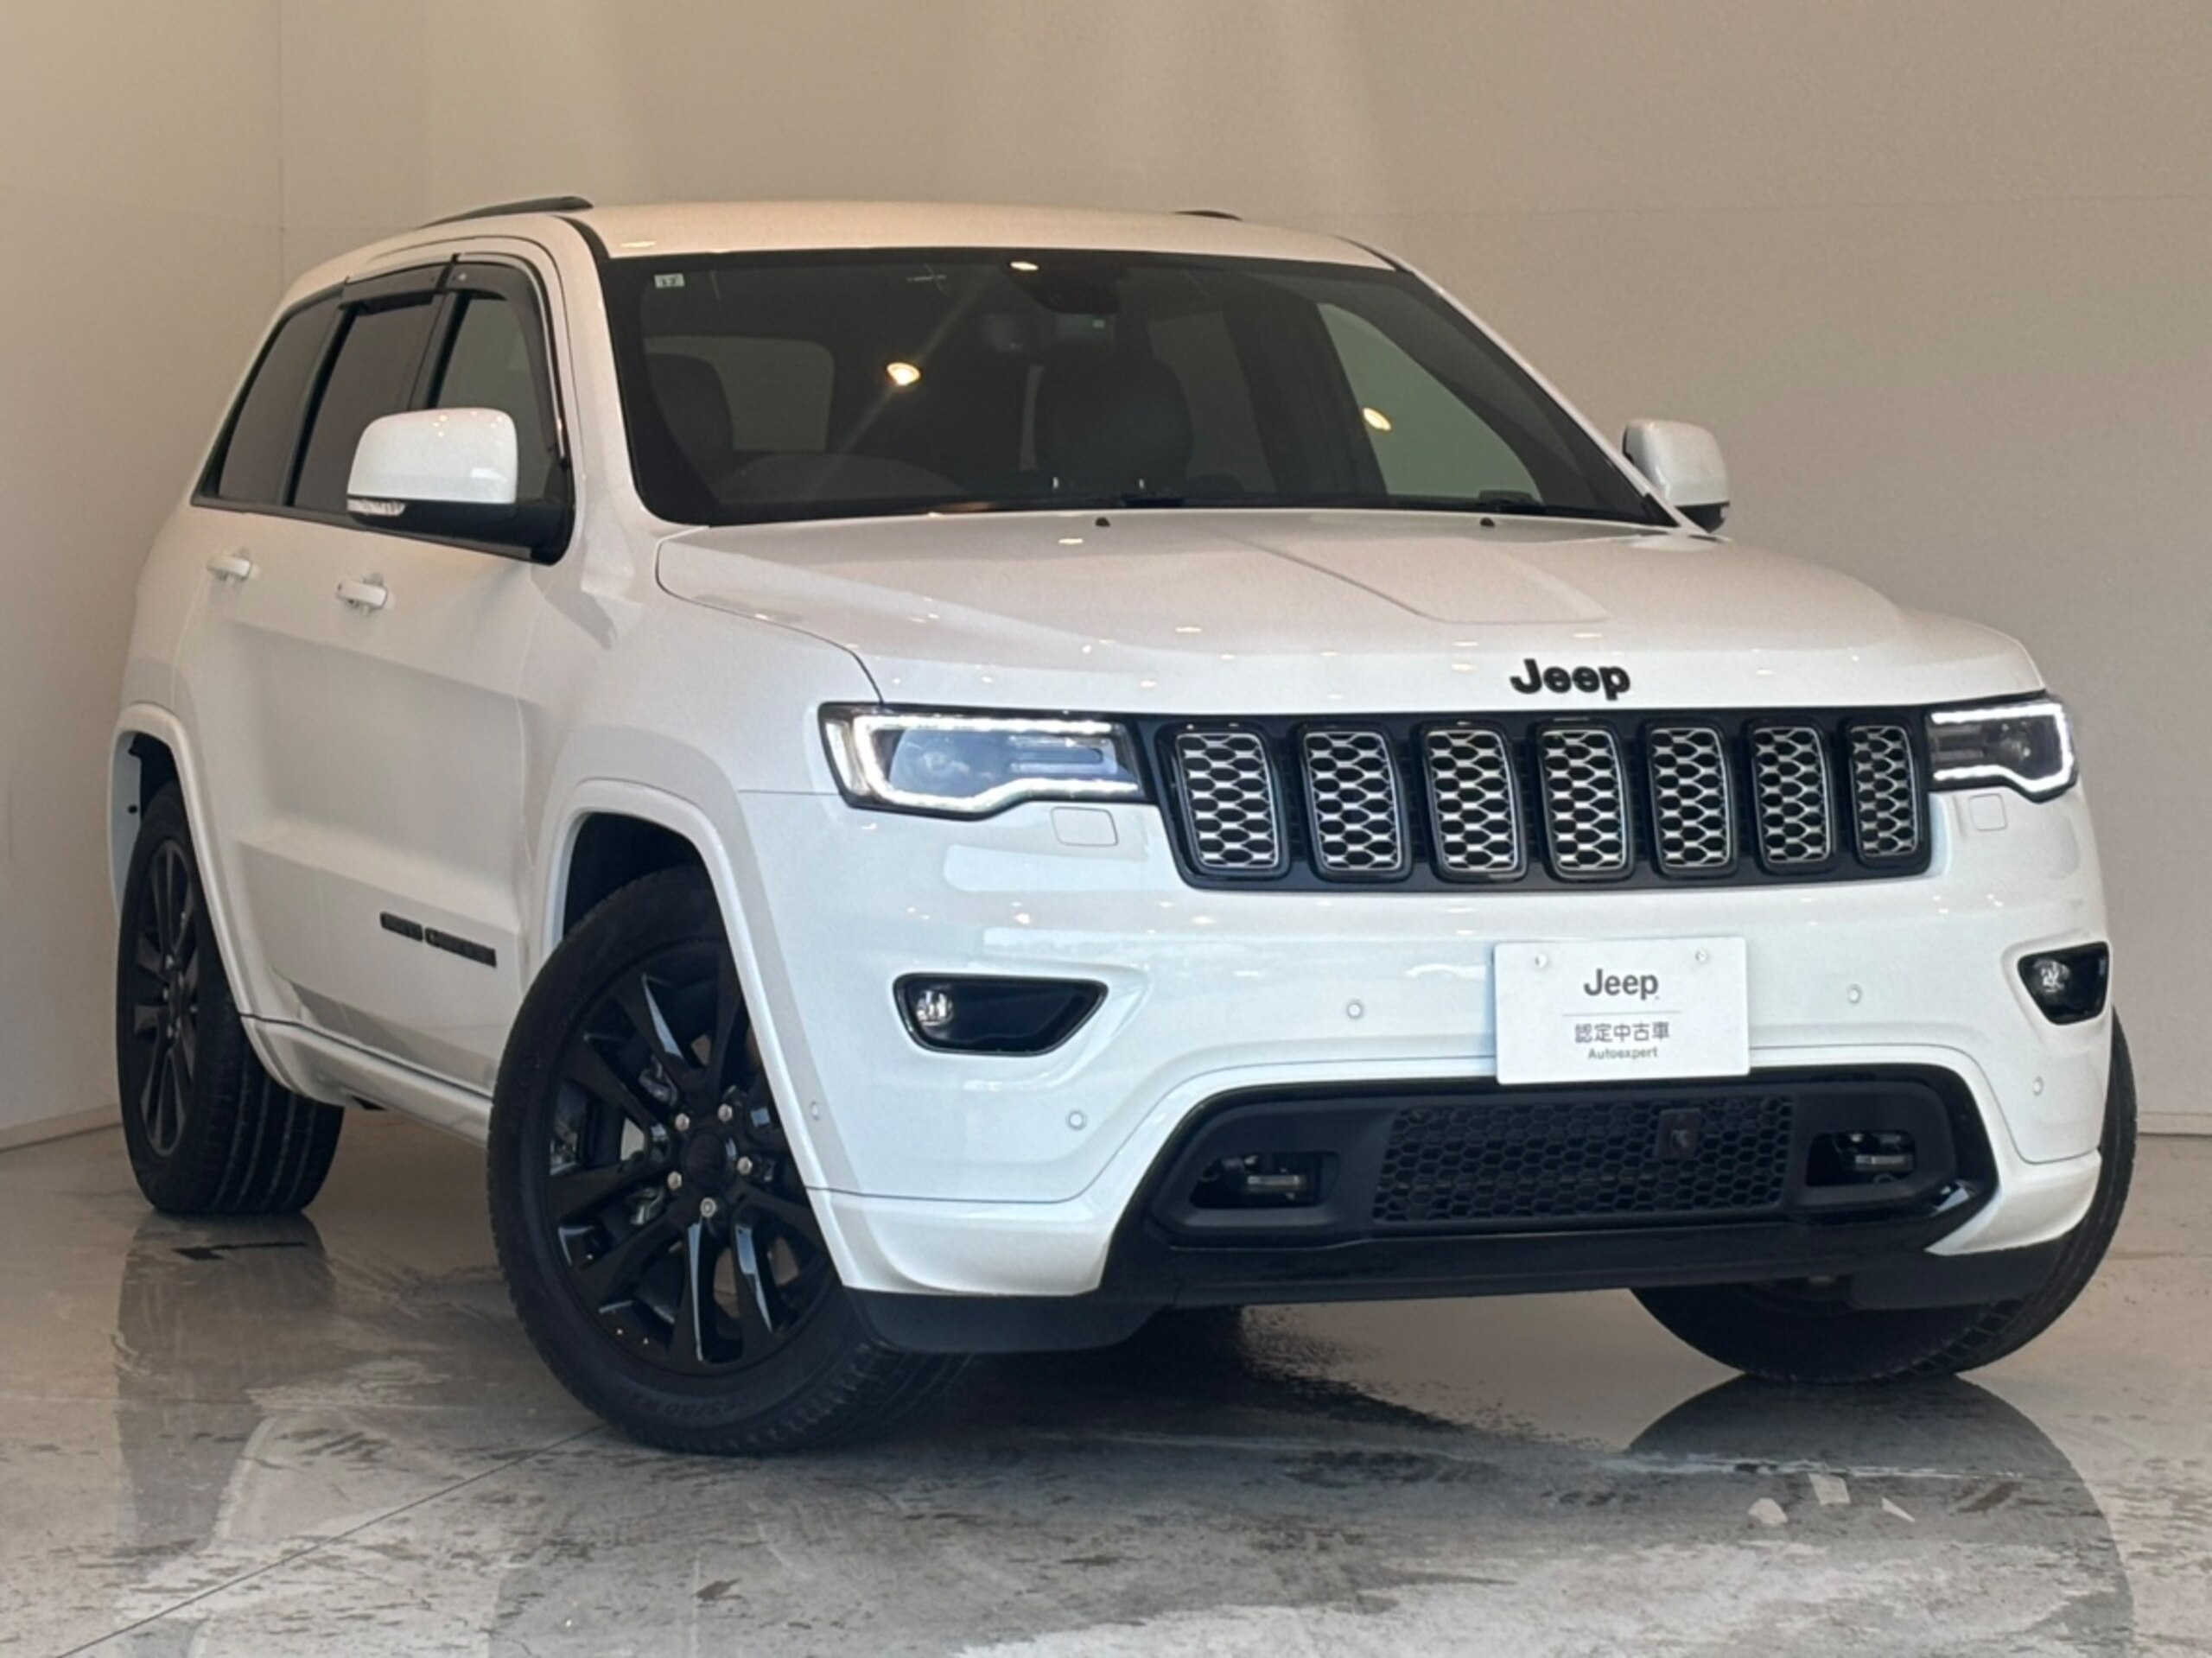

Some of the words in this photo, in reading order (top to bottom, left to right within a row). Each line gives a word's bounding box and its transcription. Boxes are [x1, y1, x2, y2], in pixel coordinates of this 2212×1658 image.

[1510, 658, 1630, 701] Jeep
[1583, 968, 1659, 1001] Jeep
[1574, 1021, 1669, 1043] 認定中古車
[1587, 1046, 1658, 1059] Autoexpert
